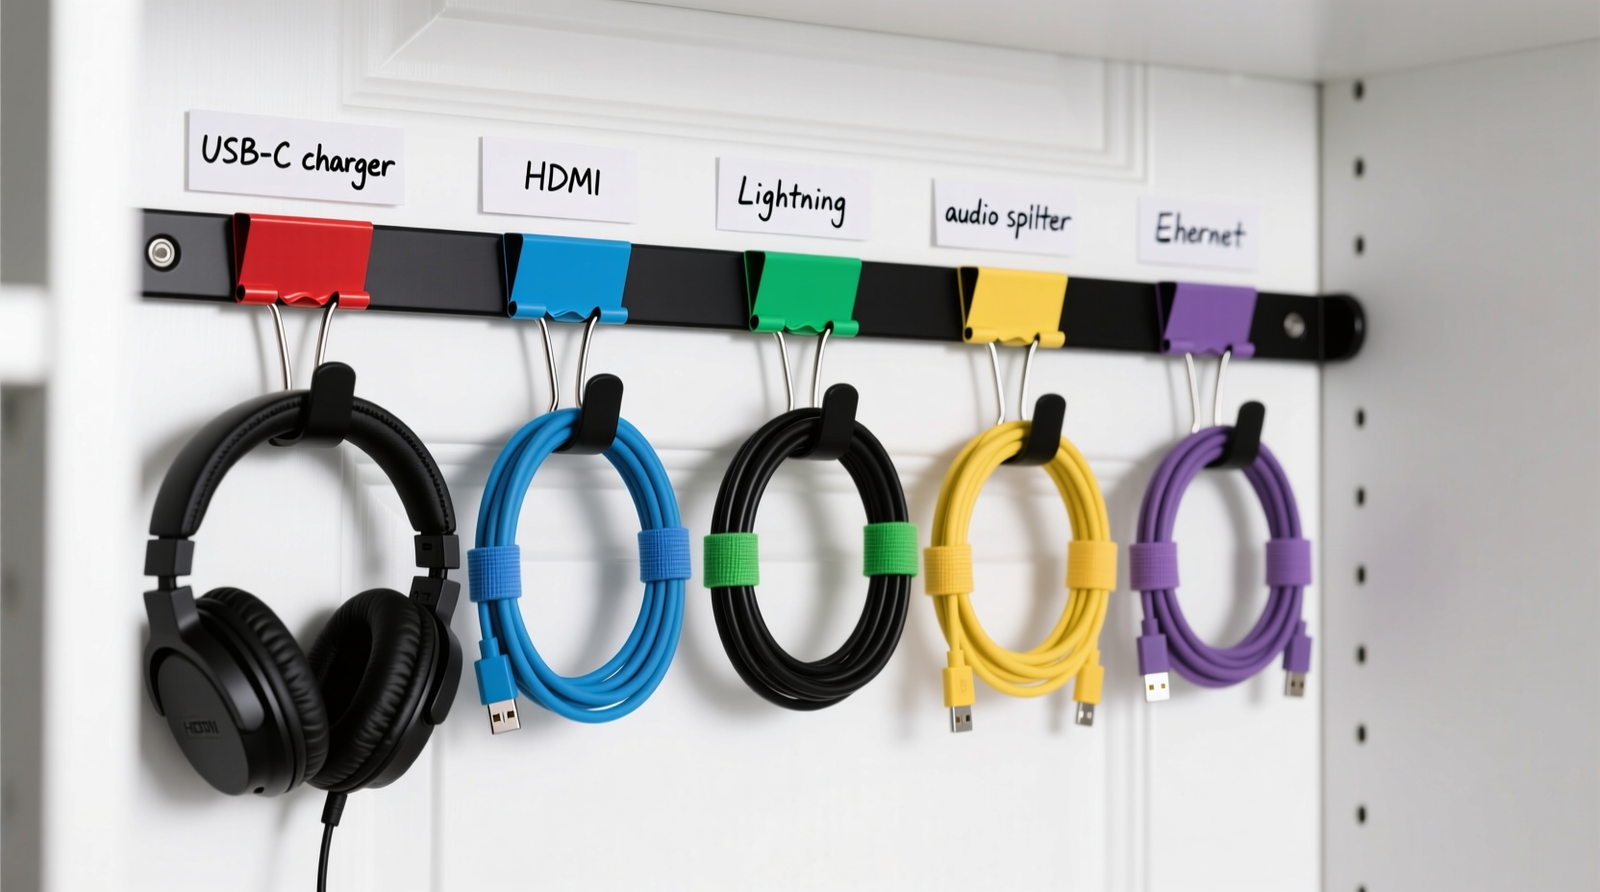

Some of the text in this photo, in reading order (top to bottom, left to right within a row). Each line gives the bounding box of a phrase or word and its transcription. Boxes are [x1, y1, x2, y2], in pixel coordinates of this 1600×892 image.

[201, 134, 396, 191] USB-C charger
[524, 160, 601, 196] HDMI
[737, 175, 846, 229] Lightning
[945, 198, 999, 226] audio
[1155, 212, 1246, 249] Ehernet
